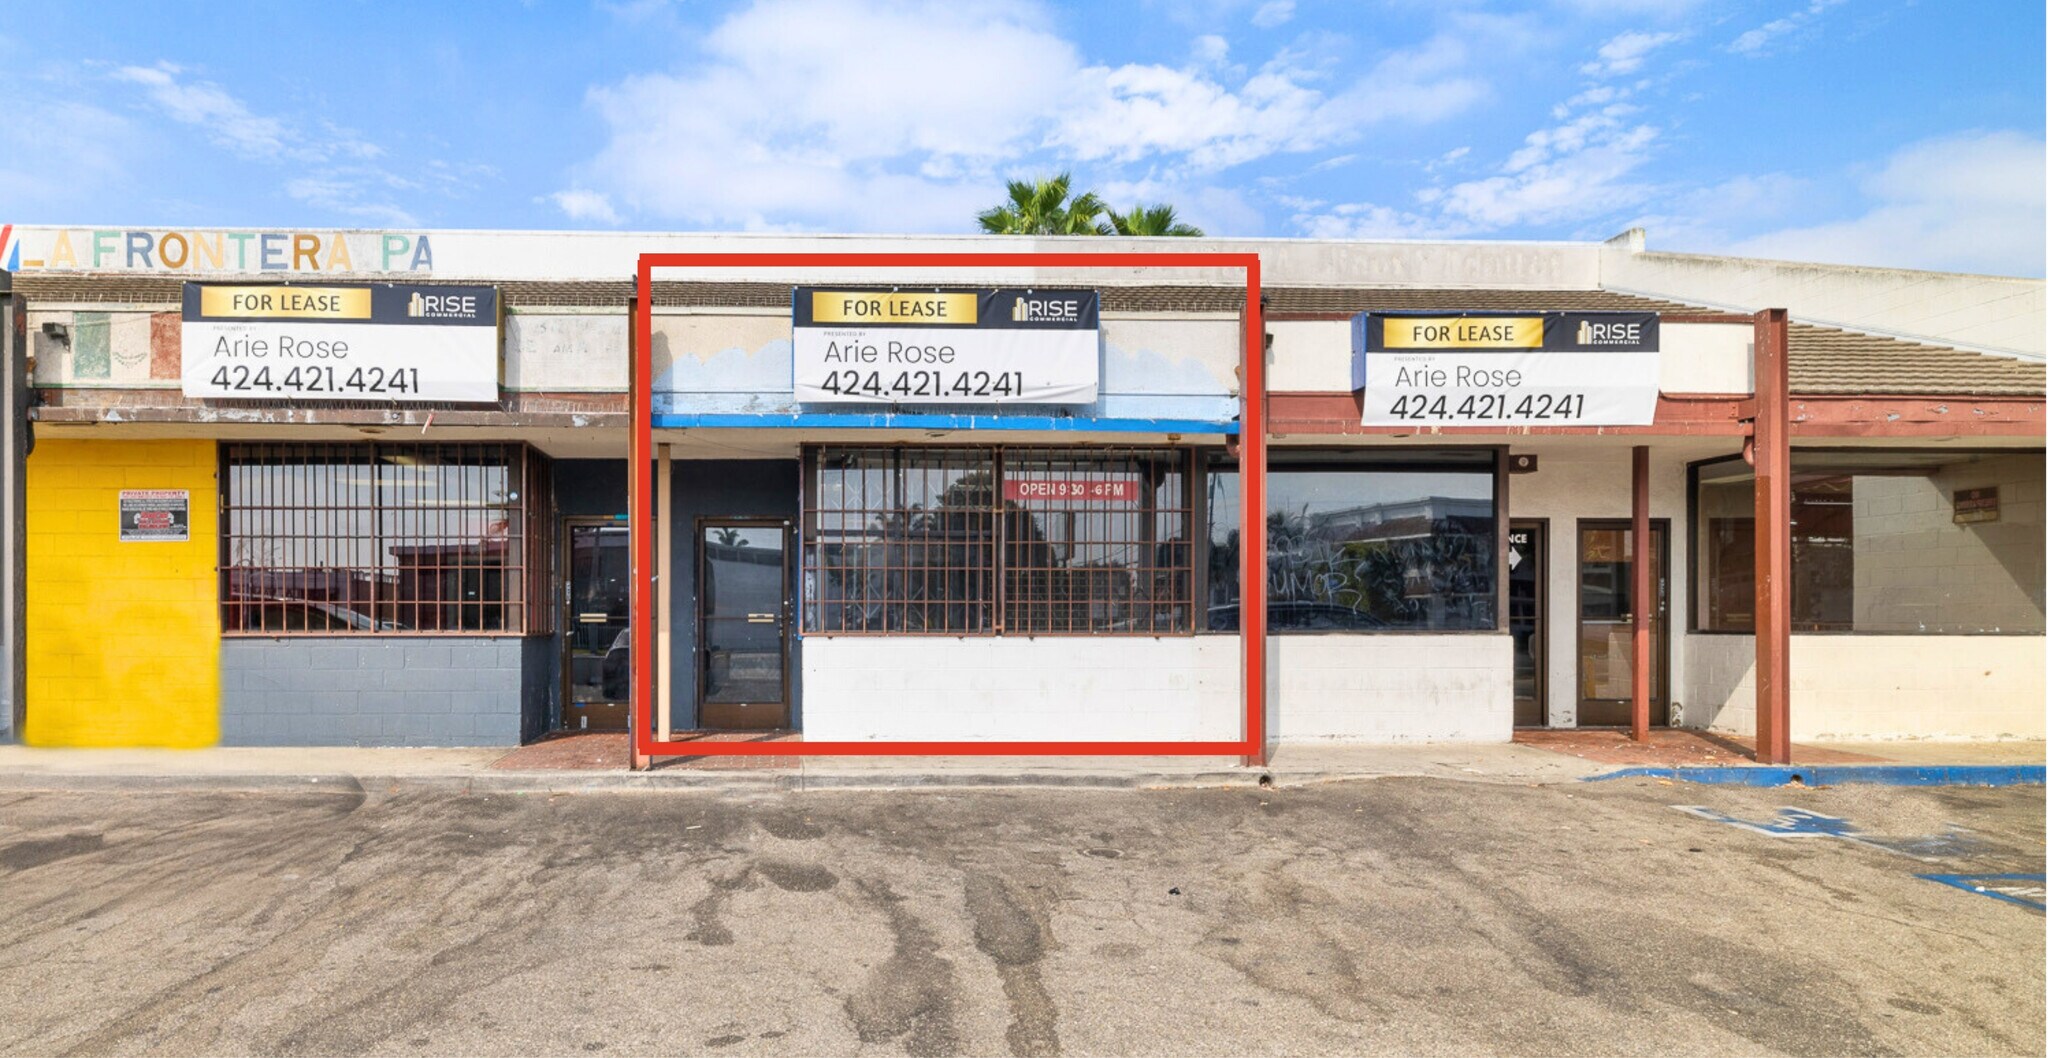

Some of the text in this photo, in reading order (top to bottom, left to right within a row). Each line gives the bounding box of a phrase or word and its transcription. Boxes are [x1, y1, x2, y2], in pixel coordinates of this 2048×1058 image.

[93, 231, 353, 270] FRONTERA
[382, 234, 432, 270] PA
[233, 294, 341, 312] FOR LEASE
[425, 296, 476, 312] RISE
[843, 300, 947, 317] FOR LEASE
[1029, 300, 1078, 316] RISE
[1413, 326, 1514, 342] FOR LEASE
[1593, 323, 1640, 340] RISE
[214, 334, 349, 359] Arie Rose
[824, 339, 955, 364] Arie Rose
[211, 365, 418, 393] 424.421.4241
[821, 370, 1022, 397] 424.421.4241
[1395, 364, 1522, 388] Arie Rose
[1389, 394, 1585, 420] 424.421.4241
[1020, 483, 1056, 496] OPEN
[1059, 483, 1085, 496] 9:30
